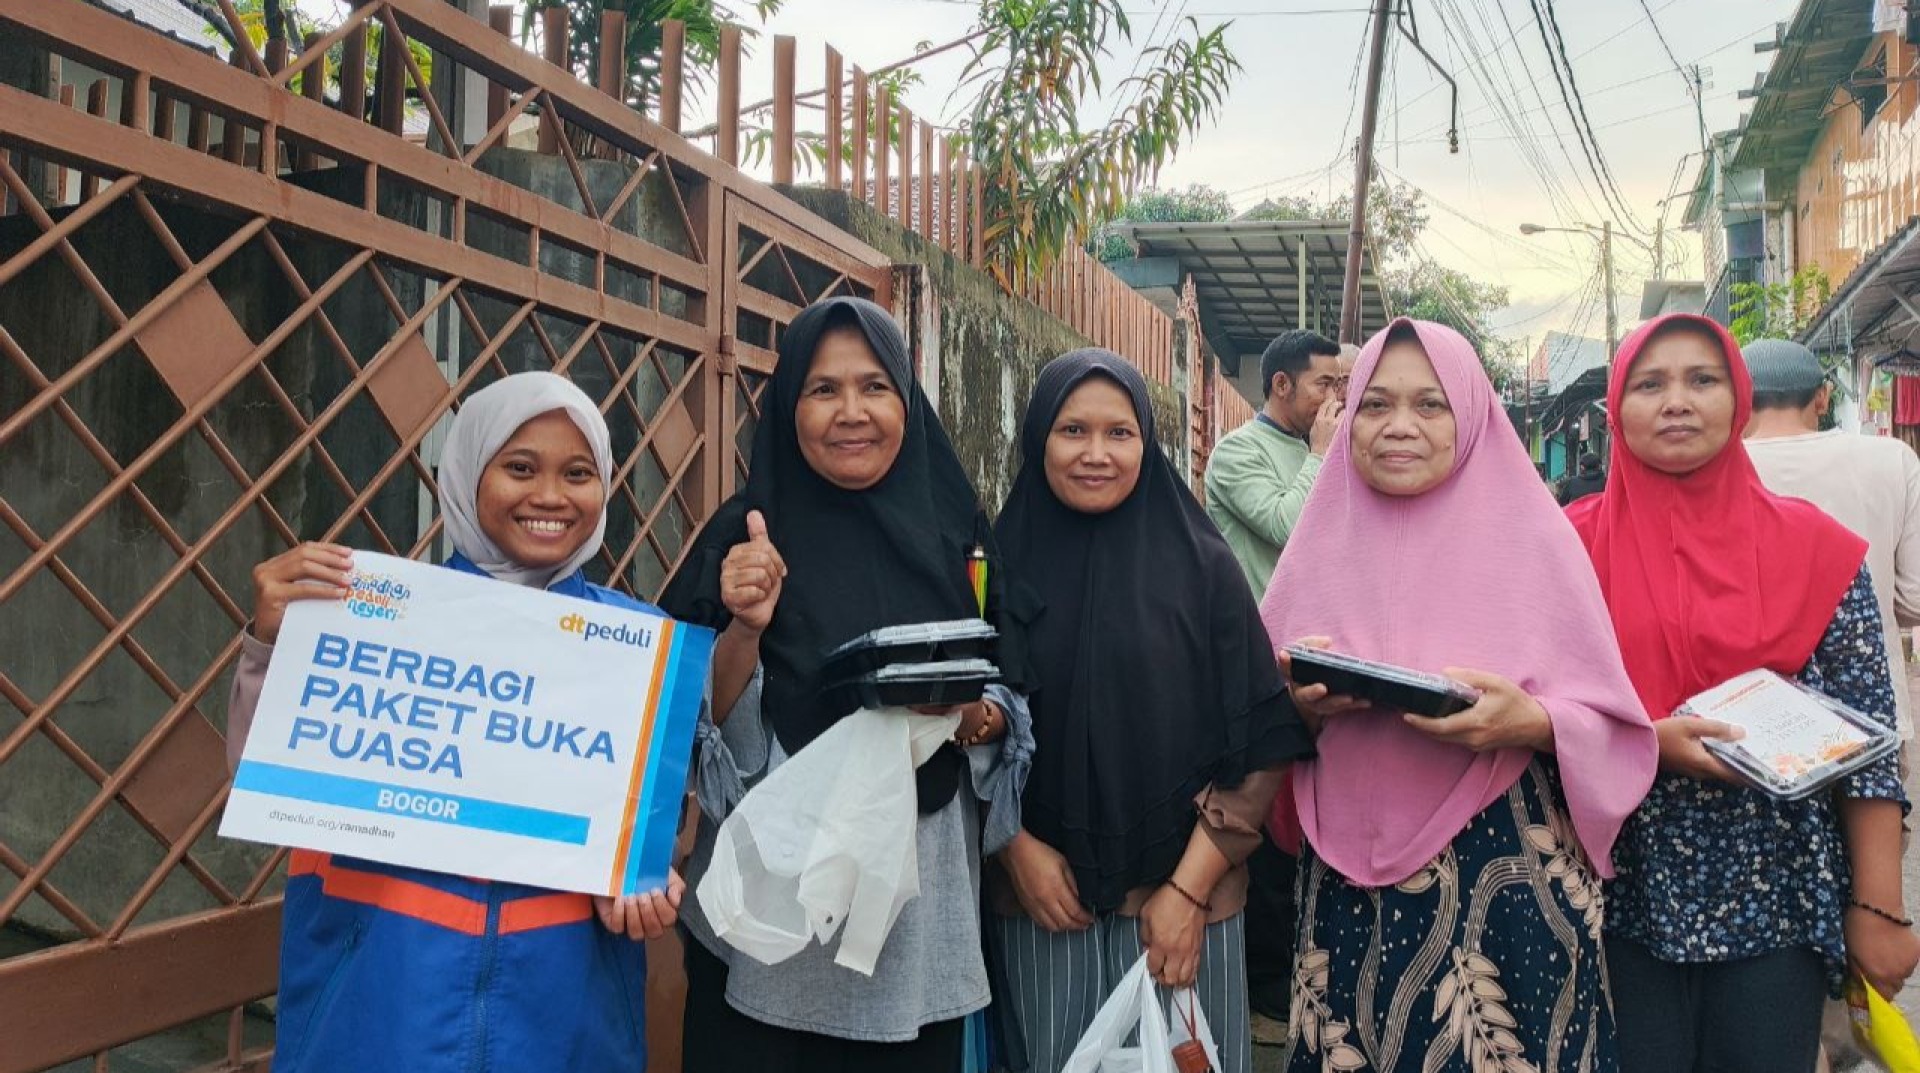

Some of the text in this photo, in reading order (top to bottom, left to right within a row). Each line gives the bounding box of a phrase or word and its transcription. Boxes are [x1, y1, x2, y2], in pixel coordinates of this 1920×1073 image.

[349, 577, 411, 600] amadhan
[559, 612, 652, 648] dtpeduli
[311, 632, 536, 706] BERBAGI
[299, 674, 616, 763] PAKET BUKA
[287, 716, 464, 779] PUASA
[377, 788, 460, 820] BOGOR
[269, 809, 396, 839] dtpeduli.org/ramadhan
